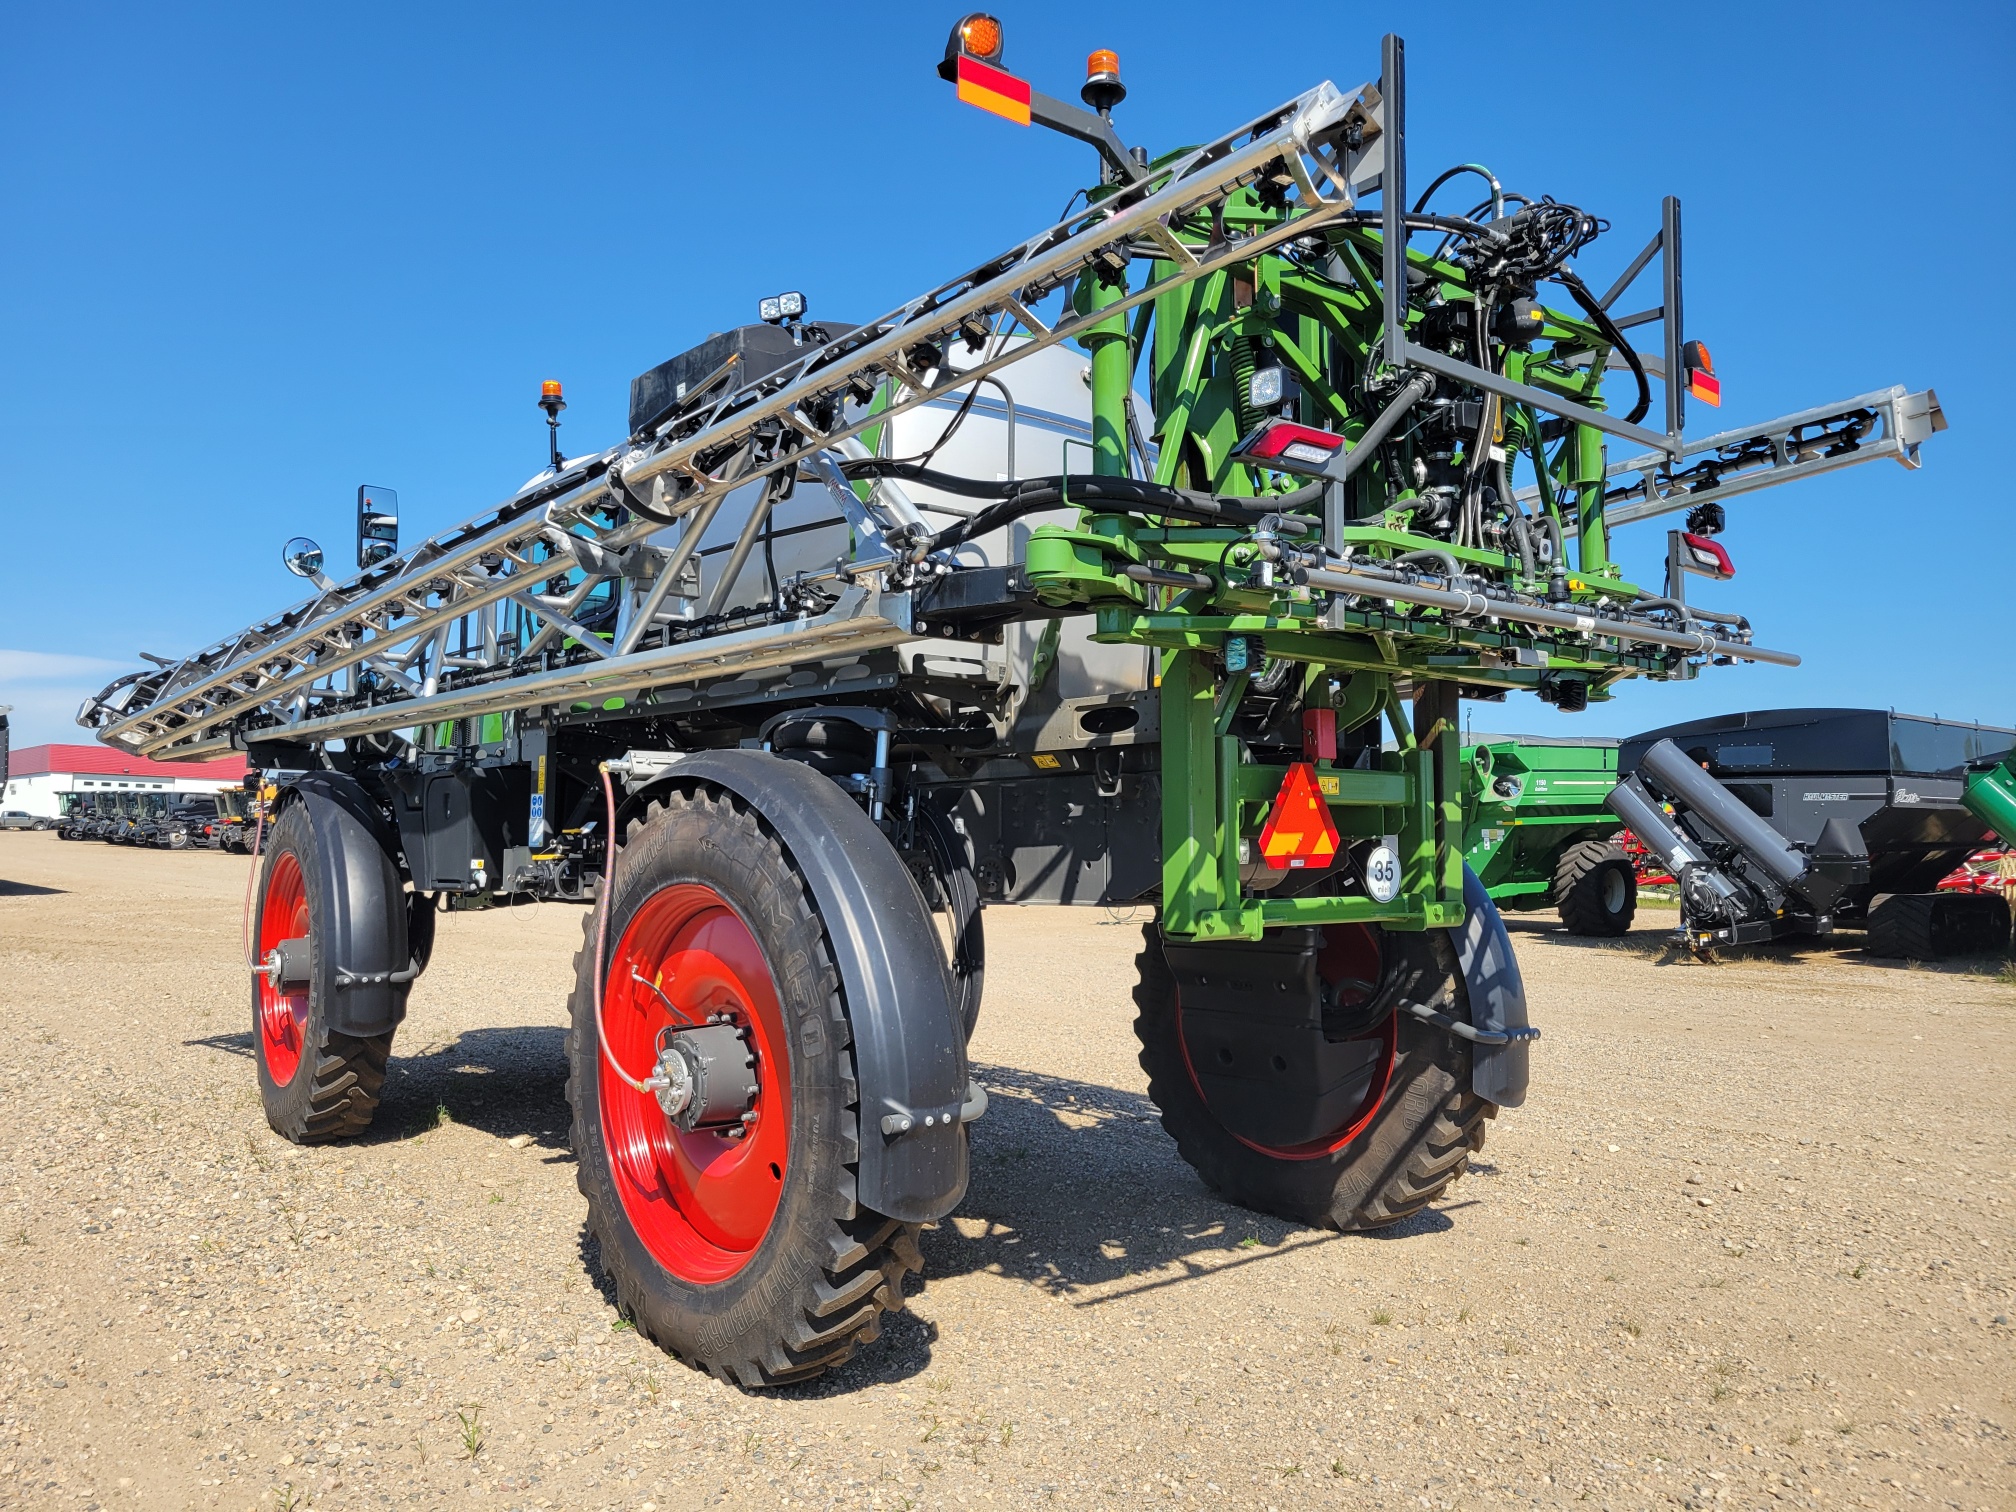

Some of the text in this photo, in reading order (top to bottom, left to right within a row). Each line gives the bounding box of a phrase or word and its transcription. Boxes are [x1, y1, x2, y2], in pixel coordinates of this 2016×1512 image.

[1374, 860, 1394, 882] 35
[785, 949, 826, 1059] 150
[694, 1243, 814, 1358] TRELLEBORG
